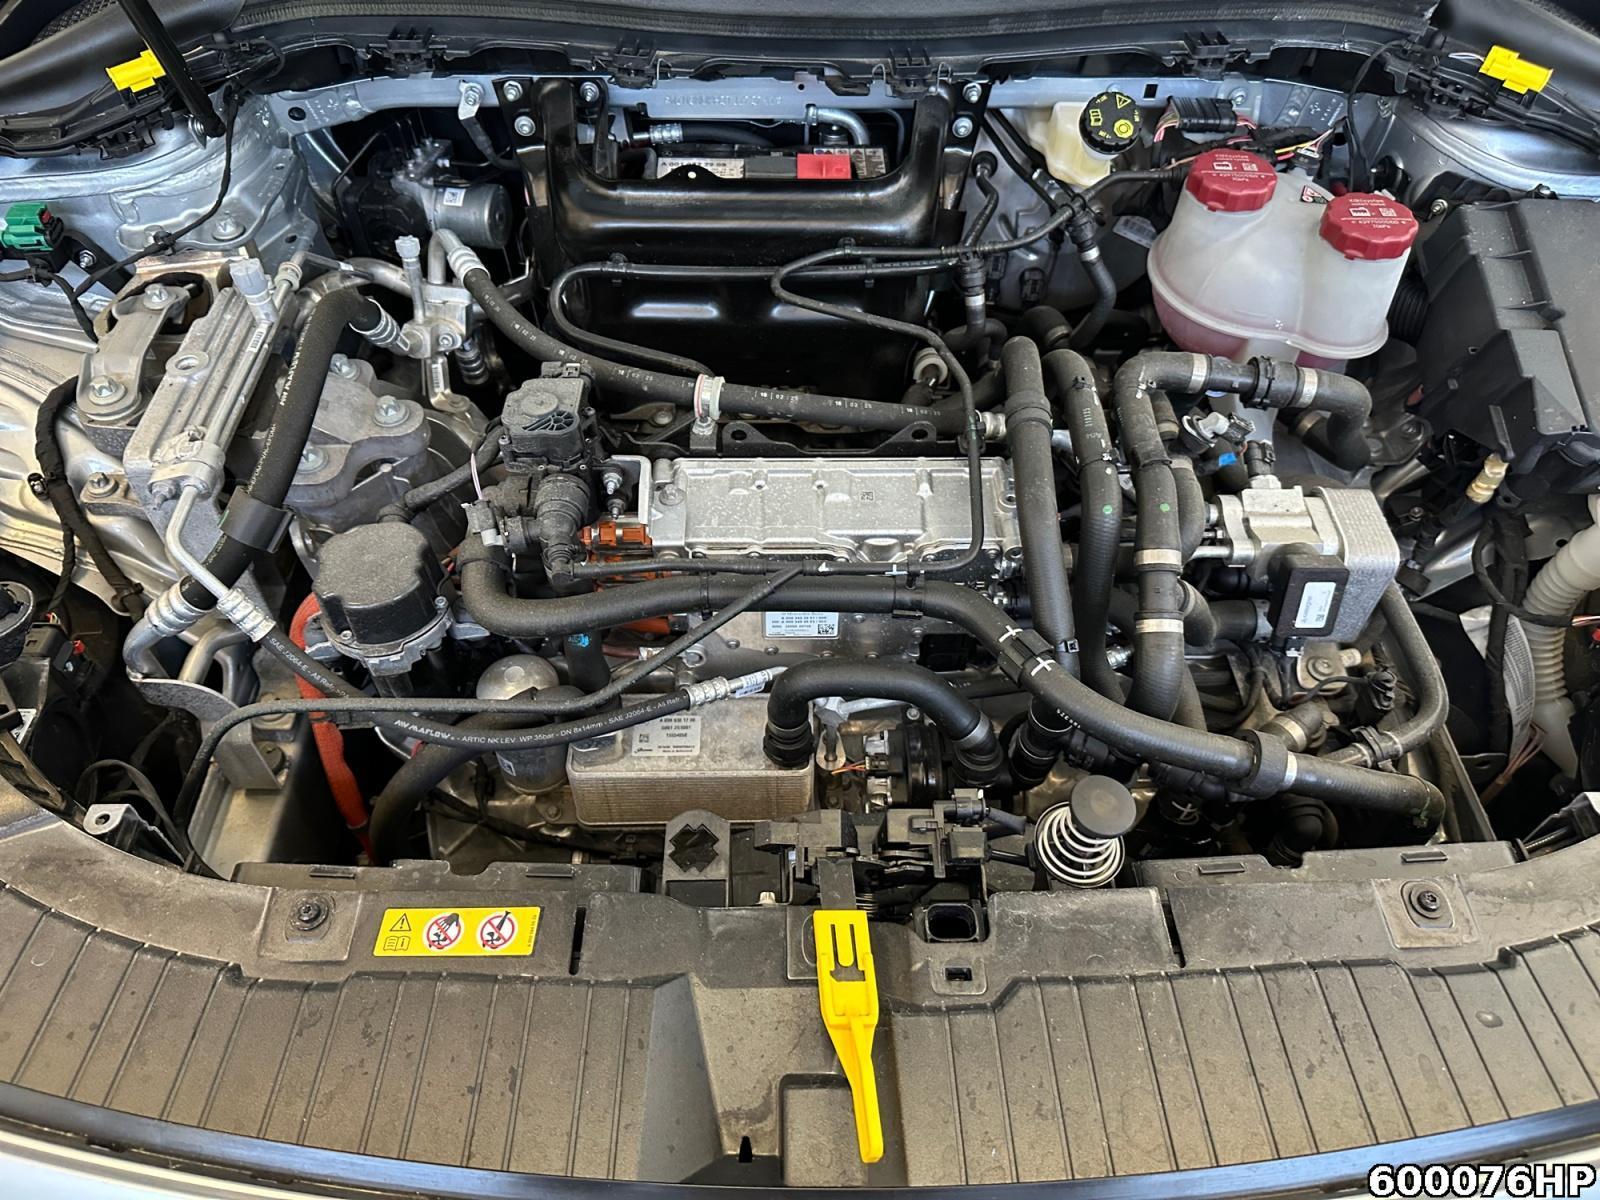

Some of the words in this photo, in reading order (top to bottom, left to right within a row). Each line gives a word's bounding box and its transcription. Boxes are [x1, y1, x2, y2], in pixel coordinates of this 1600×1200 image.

[519, 735, 533, 743] WP
[560, 728, 572, 737] DN
[608, 714, 624, 724] SAE
